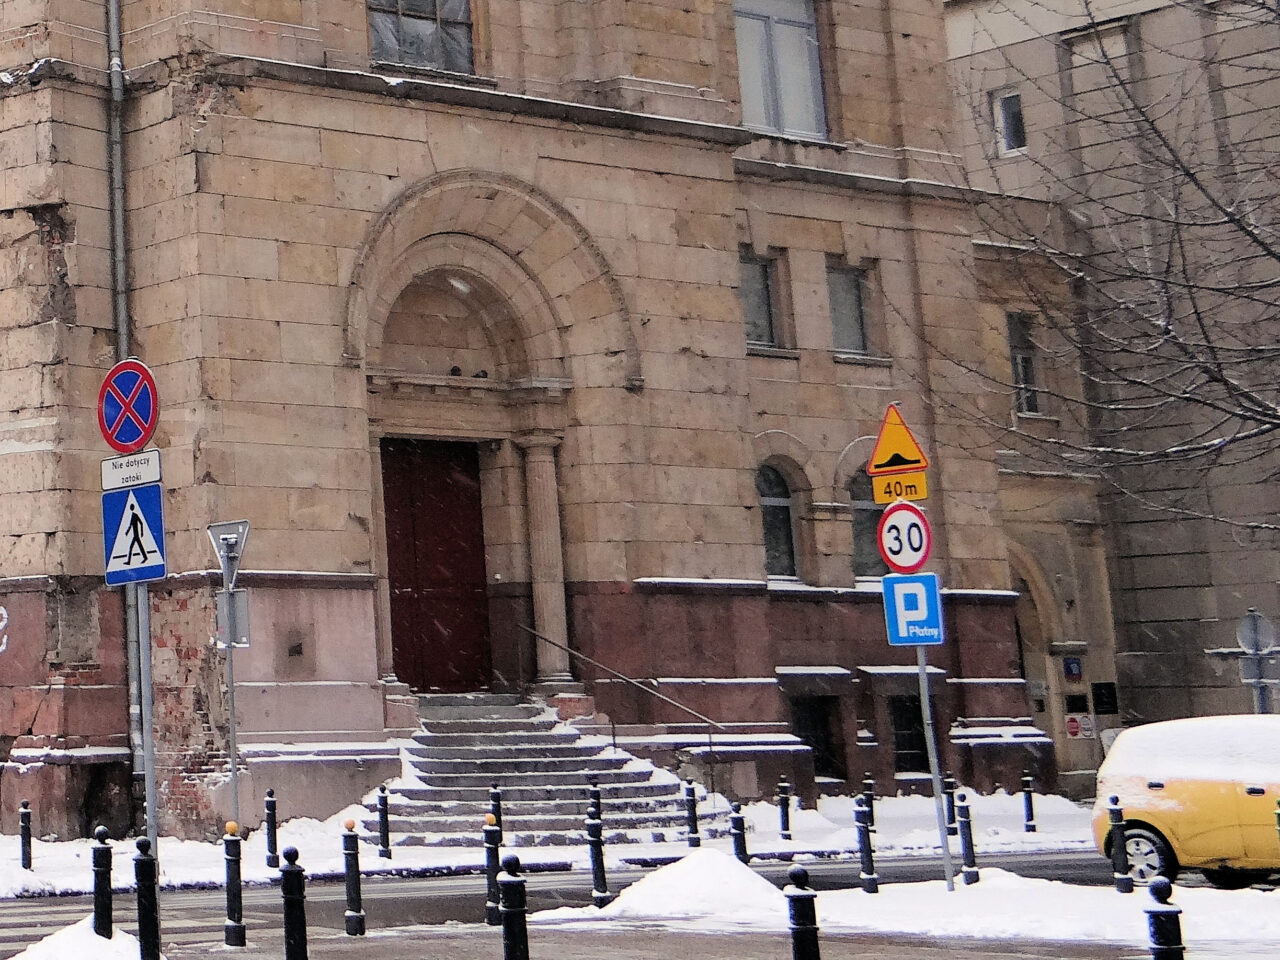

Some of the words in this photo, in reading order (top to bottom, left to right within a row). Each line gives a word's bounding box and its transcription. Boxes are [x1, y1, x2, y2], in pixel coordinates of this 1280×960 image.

[111, 461, 124, 470] Nie
[125, 457, 150, 469] dotyczy
[121, 472, 142, 484] zatoki
[883, 481, 918, 497] 40m
[886, 522, 923, 555] 30
[893, 582, 928, 637] P
